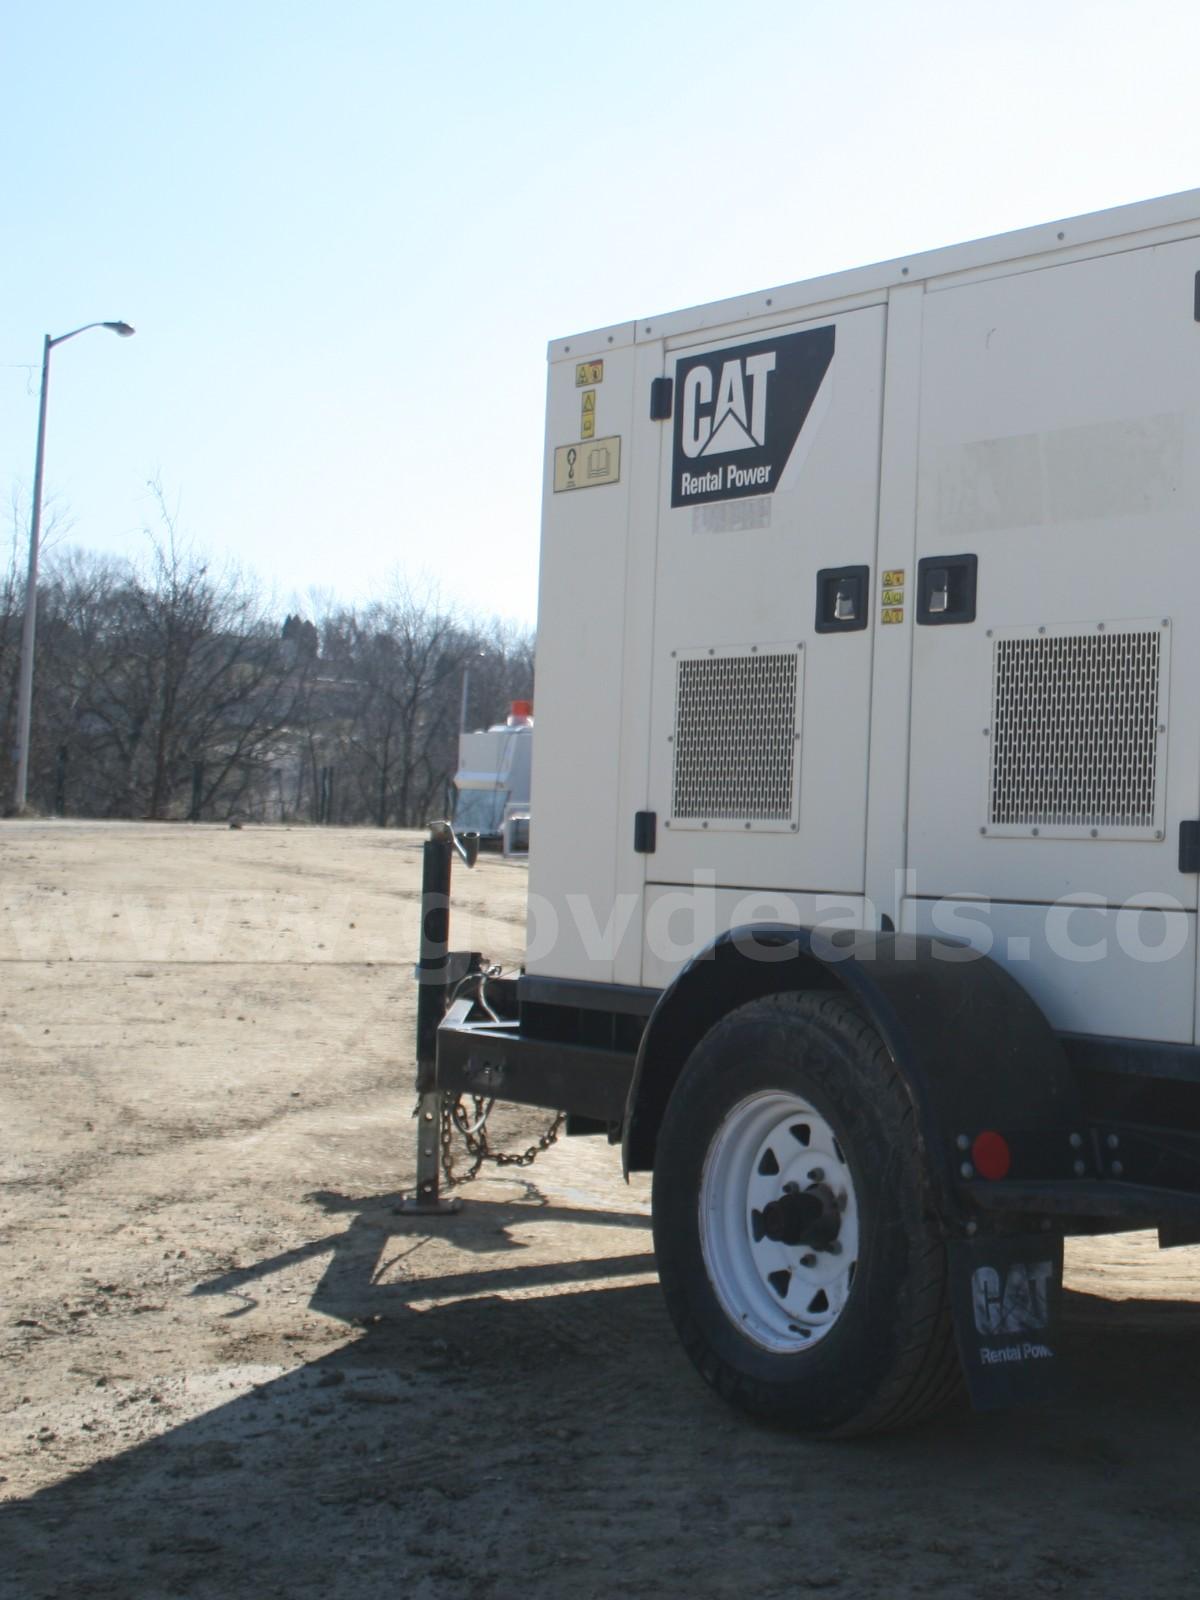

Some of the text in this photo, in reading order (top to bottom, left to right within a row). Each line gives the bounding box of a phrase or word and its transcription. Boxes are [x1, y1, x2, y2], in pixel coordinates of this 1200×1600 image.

[682, 351, 776, 458] CAT
[681, 464, 772, 496] Rental Power
[971, 1261, 1052, 1335] CAT
[980, 1346, 1021, 1365] Rental
